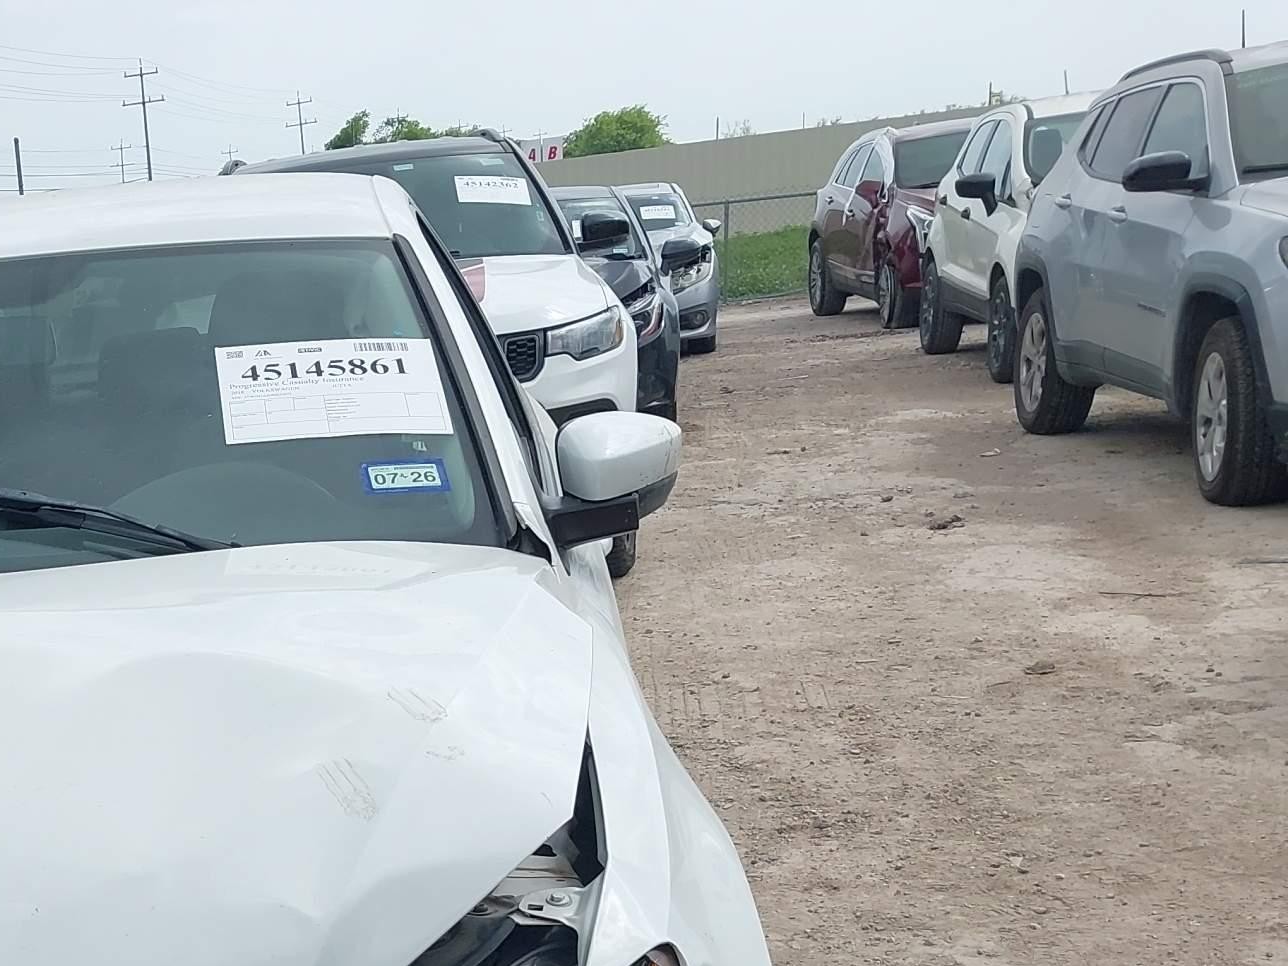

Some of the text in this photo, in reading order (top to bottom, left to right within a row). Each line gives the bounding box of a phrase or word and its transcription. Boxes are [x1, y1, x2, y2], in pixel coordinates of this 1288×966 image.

[528, 146, 558, 161] A B
[241, 358, 409, 381] 45145861
[374, 470, 436, 485] 07 26
